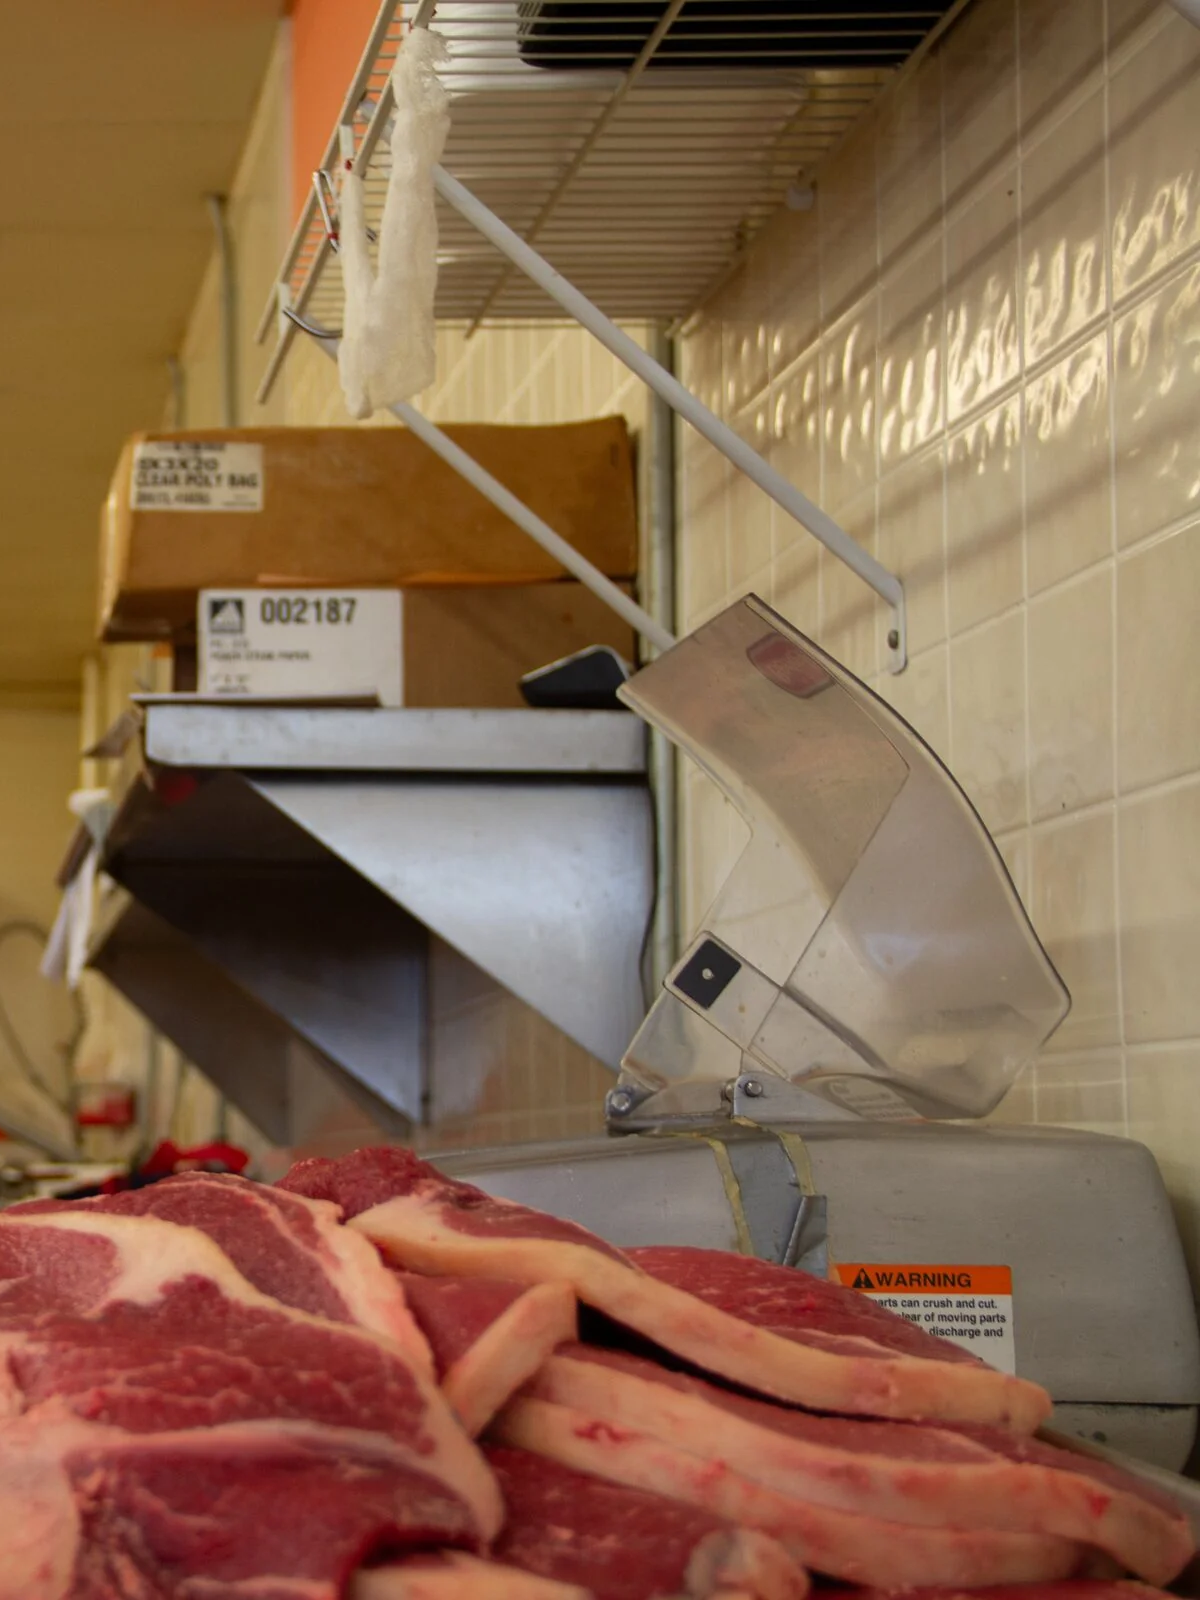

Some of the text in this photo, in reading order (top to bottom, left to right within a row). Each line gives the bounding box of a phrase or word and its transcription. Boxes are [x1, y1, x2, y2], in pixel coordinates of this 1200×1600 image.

[135, 473, 259, 488] CLEAR POLY BAG
[260, 597, 358, 625] 002187
[875, 1272, 972, 1288] WARNING
[901, 1299, 920, 1308] can
[923, 1298, 953, 1308] crush
[956, 1299, 976, 1309] and
[978, 1299, 998, 1309] cut.
[924, 1312, 936, 1323] of
[938, 1313, 977, 1325] moving
[979, 1314, 1006, 1325] parts
[929, 1326, 981, 1339] discharge
[984, 1328, 1004, 1338] and
